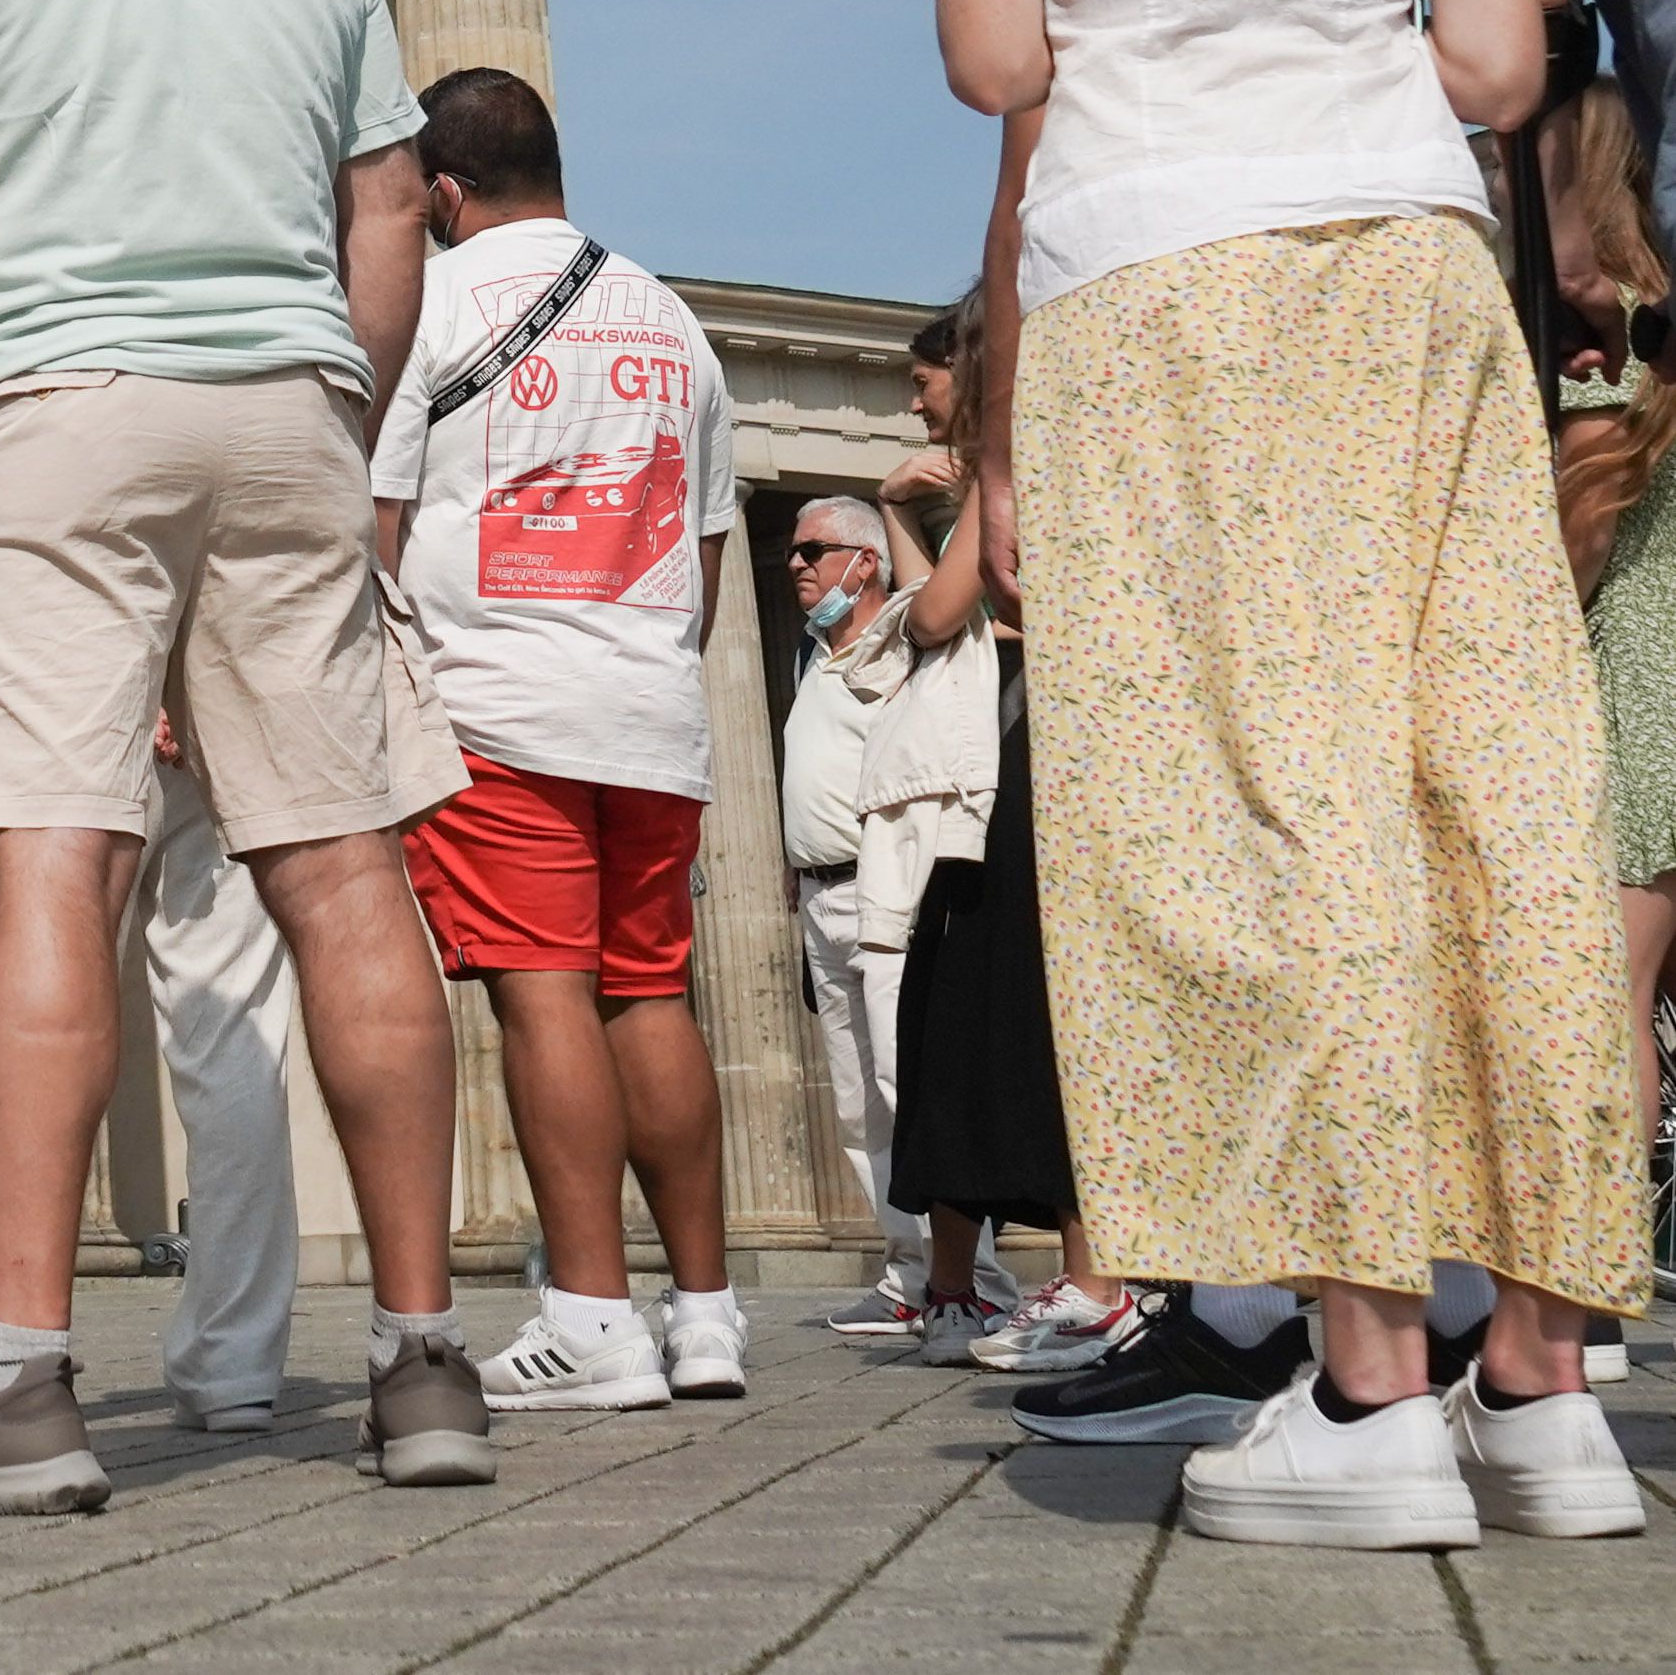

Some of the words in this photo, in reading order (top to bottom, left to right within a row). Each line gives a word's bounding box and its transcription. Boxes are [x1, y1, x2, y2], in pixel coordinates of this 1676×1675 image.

[552, 328, 685, 352] VOLKSWAGEN
[610, 354, 690, 408] GTI
[489, 551, 554, 567] SPORT
[485, 566, 624, 587] PERFORMANCE
